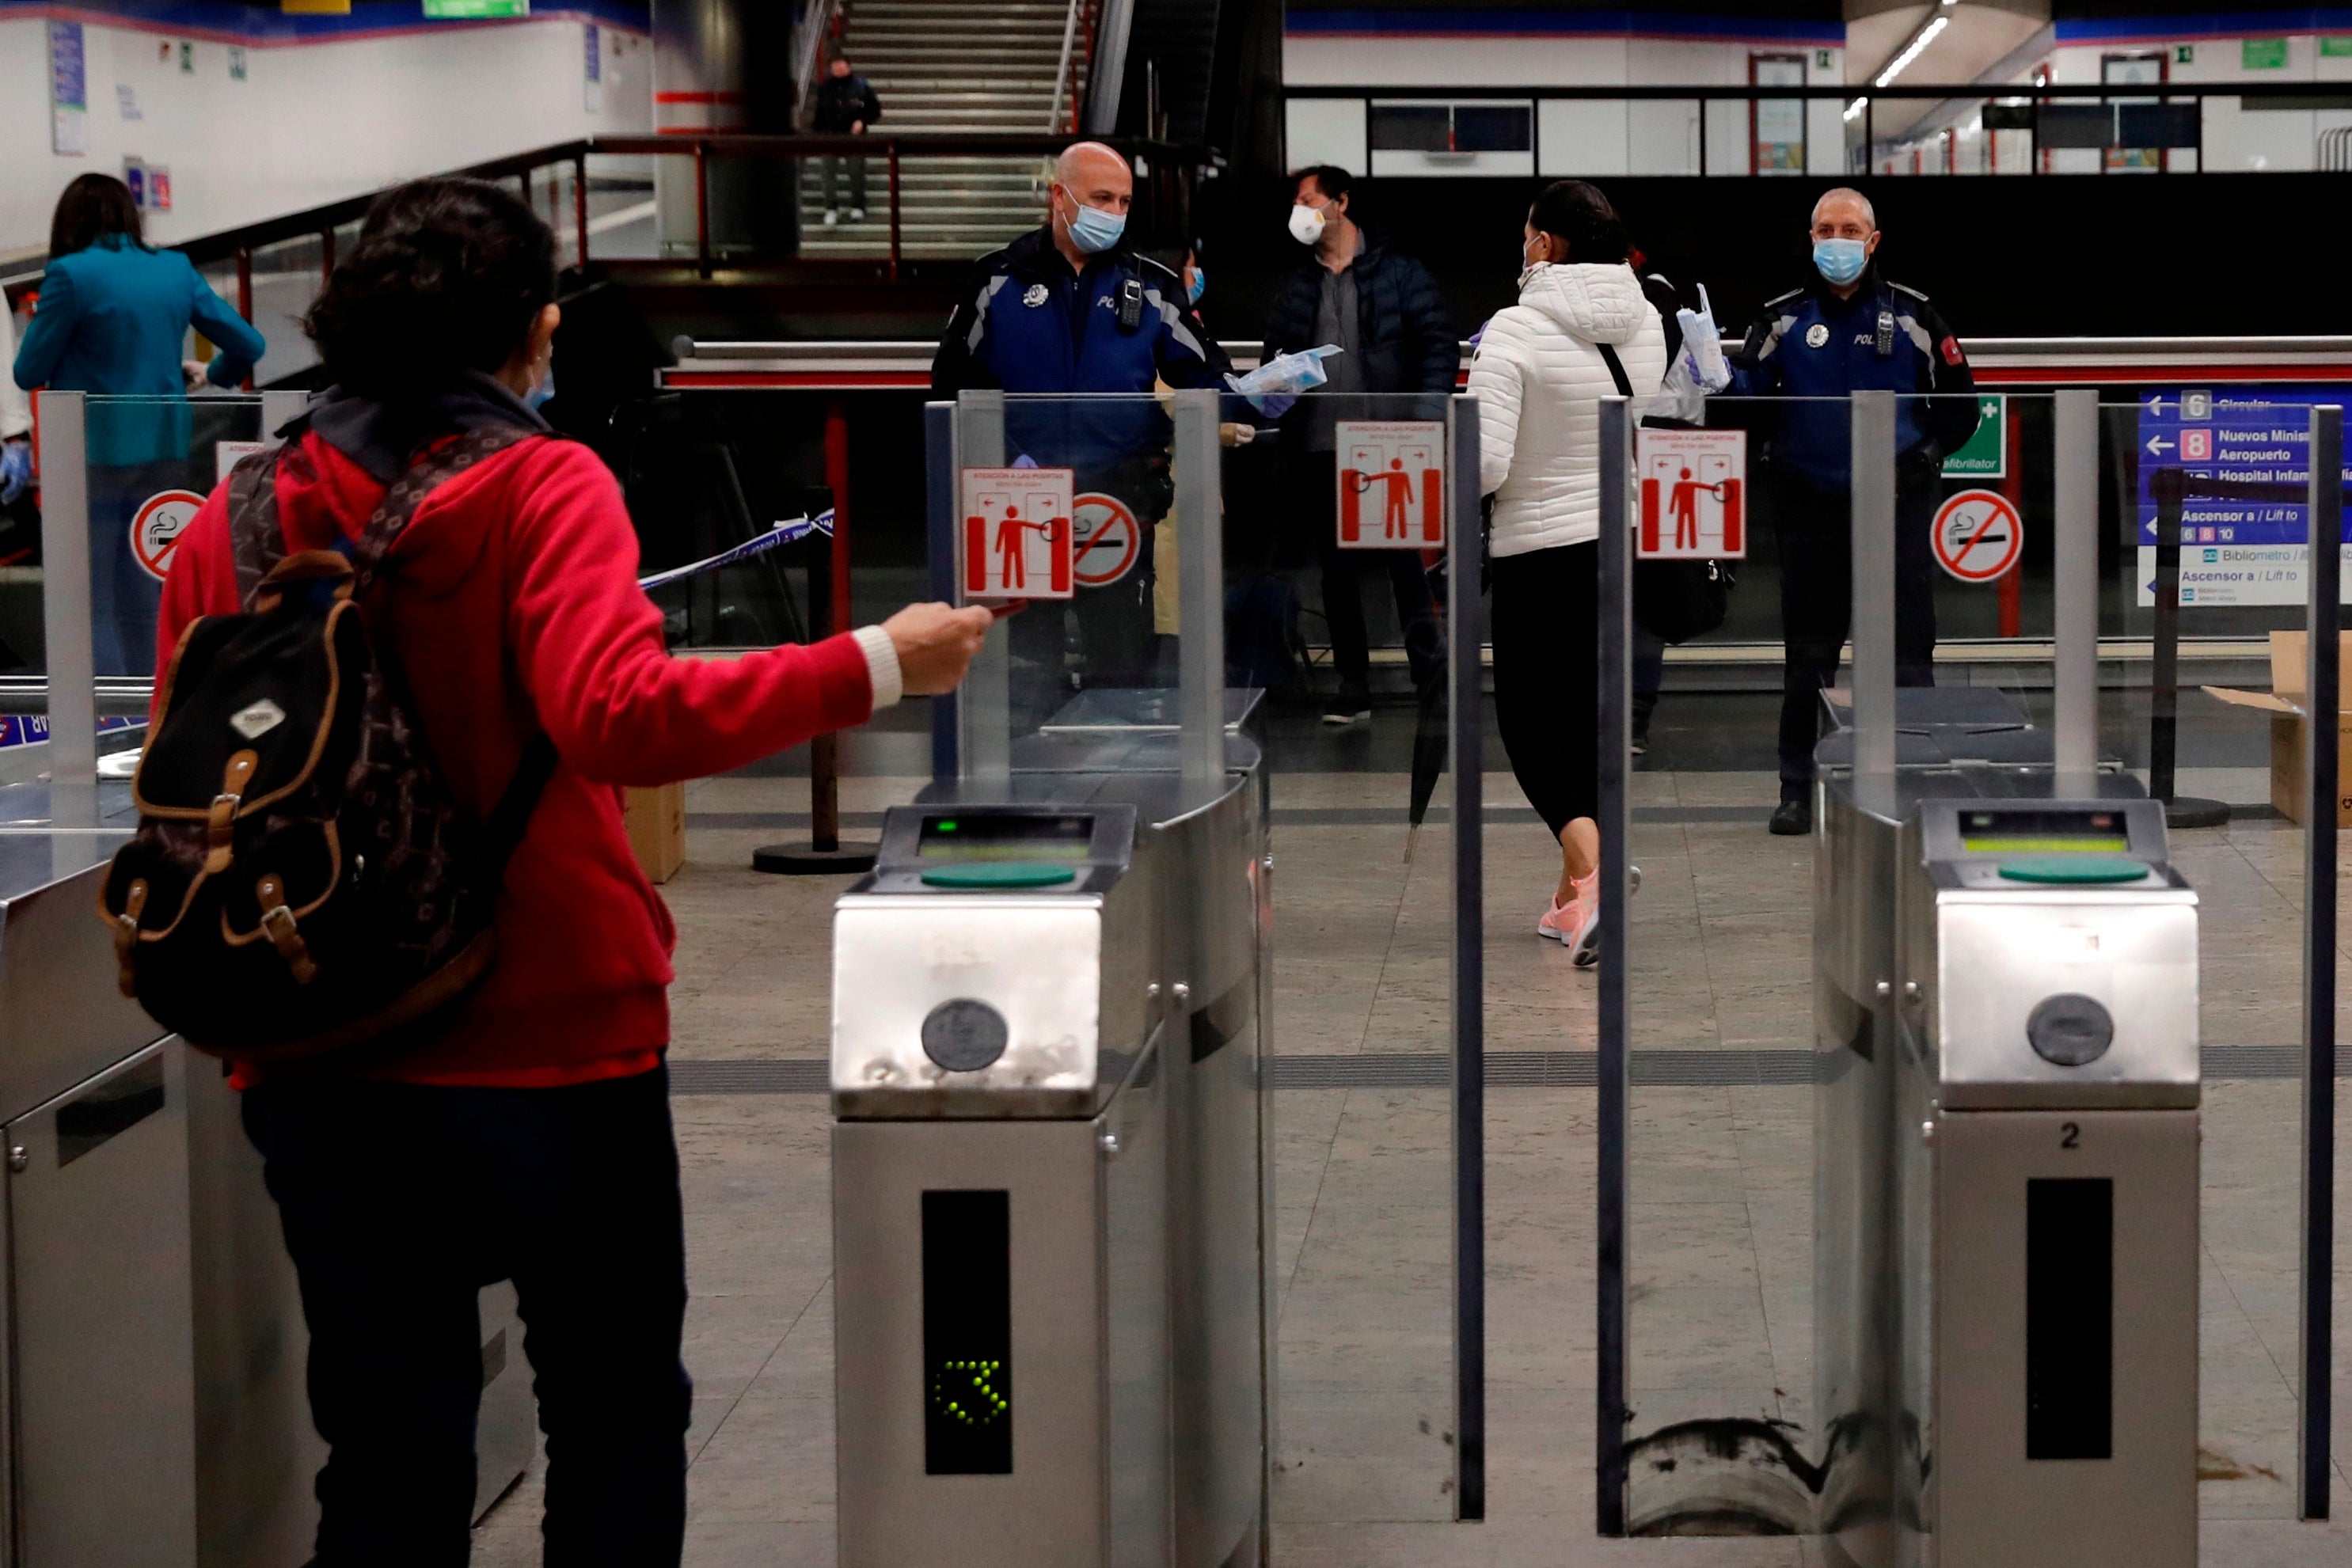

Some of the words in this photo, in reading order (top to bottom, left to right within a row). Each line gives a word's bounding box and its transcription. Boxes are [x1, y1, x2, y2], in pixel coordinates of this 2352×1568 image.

[2188, 394, 2206, 416] 6
[2219, 399, 2270, 412] Circular
[2188, 434, 2206, 457] 8
[2219, 430, 2268, 442] Nuevos
[2219, 449, 2291, 462] Aeropuerto
[1944, 459, 1997, 469] efibrillator
[2219, 469, 2273, 482] Hospital
[2181, 511, 2244, 522] Ascensor
[2247, 513, 2255, 522] a
[2266, 509, 2283, 521] Lift
[2286, 510, 2298, 521] to
[2184, 528, 2193, 539] 6
[2202, 529, 2212, 539] 8
[2219, 528, 2233, 540] 10
[2223, 549, 2290, 561] Bibliometro
[2182, 571, 2244, 582] Ascensor
[2266, 571, 2283, 581] Lift
[2286, 571, 2297, 581] to
[2061, 1121, 2079, 1148] 2
